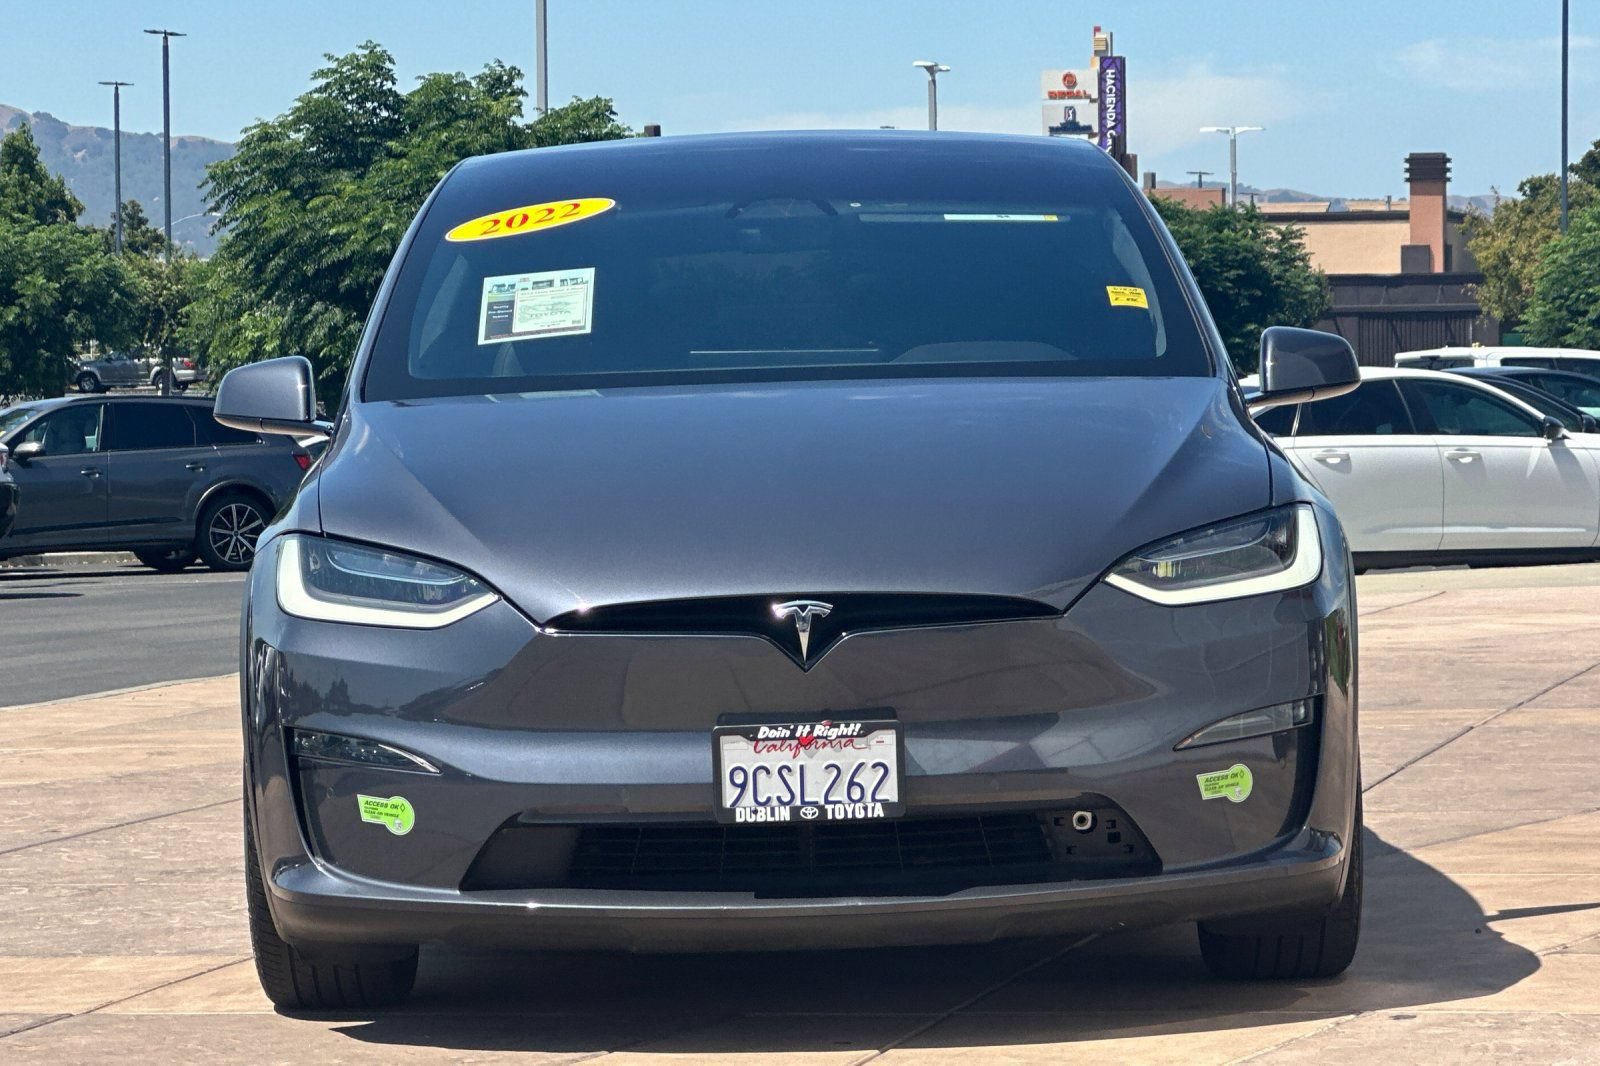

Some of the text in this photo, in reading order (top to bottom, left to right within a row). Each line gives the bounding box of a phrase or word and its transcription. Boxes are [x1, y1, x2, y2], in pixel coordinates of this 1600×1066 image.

[1105, 69, 1116, 128] HACIENDA
[479, 203, 581, 236] 2022
[757, 723, 862, 740] Doin' It Right!
[729, 761, 890, 808] 9CSL262
[1204, 774, 1229, 783] ACCESS
[364, 800, 388, 808] ACCESS
[735, 803, 884, 823] DUBLIN TOYOTA
